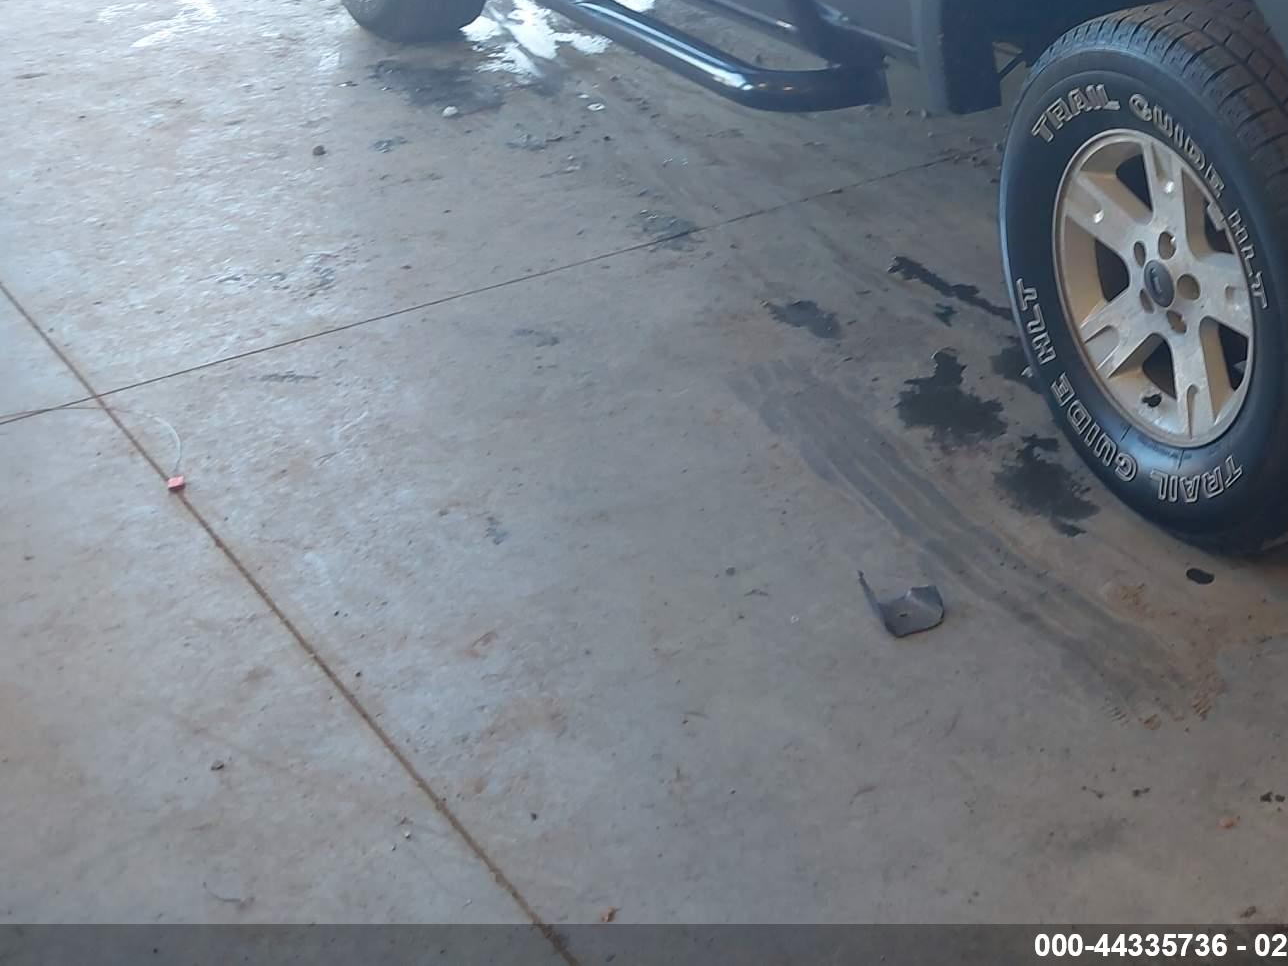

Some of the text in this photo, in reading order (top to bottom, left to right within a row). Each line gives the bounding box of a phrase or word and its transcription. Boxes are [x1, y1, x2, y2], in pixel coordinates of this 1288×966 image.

[1031, 83, 1121, 143] TRAIL
[1128, 93, 1225, 199] GUIDE
[1051, 372, 1138, 483] GUIDE
[1151, 454, 1243, 503] TRAIL
